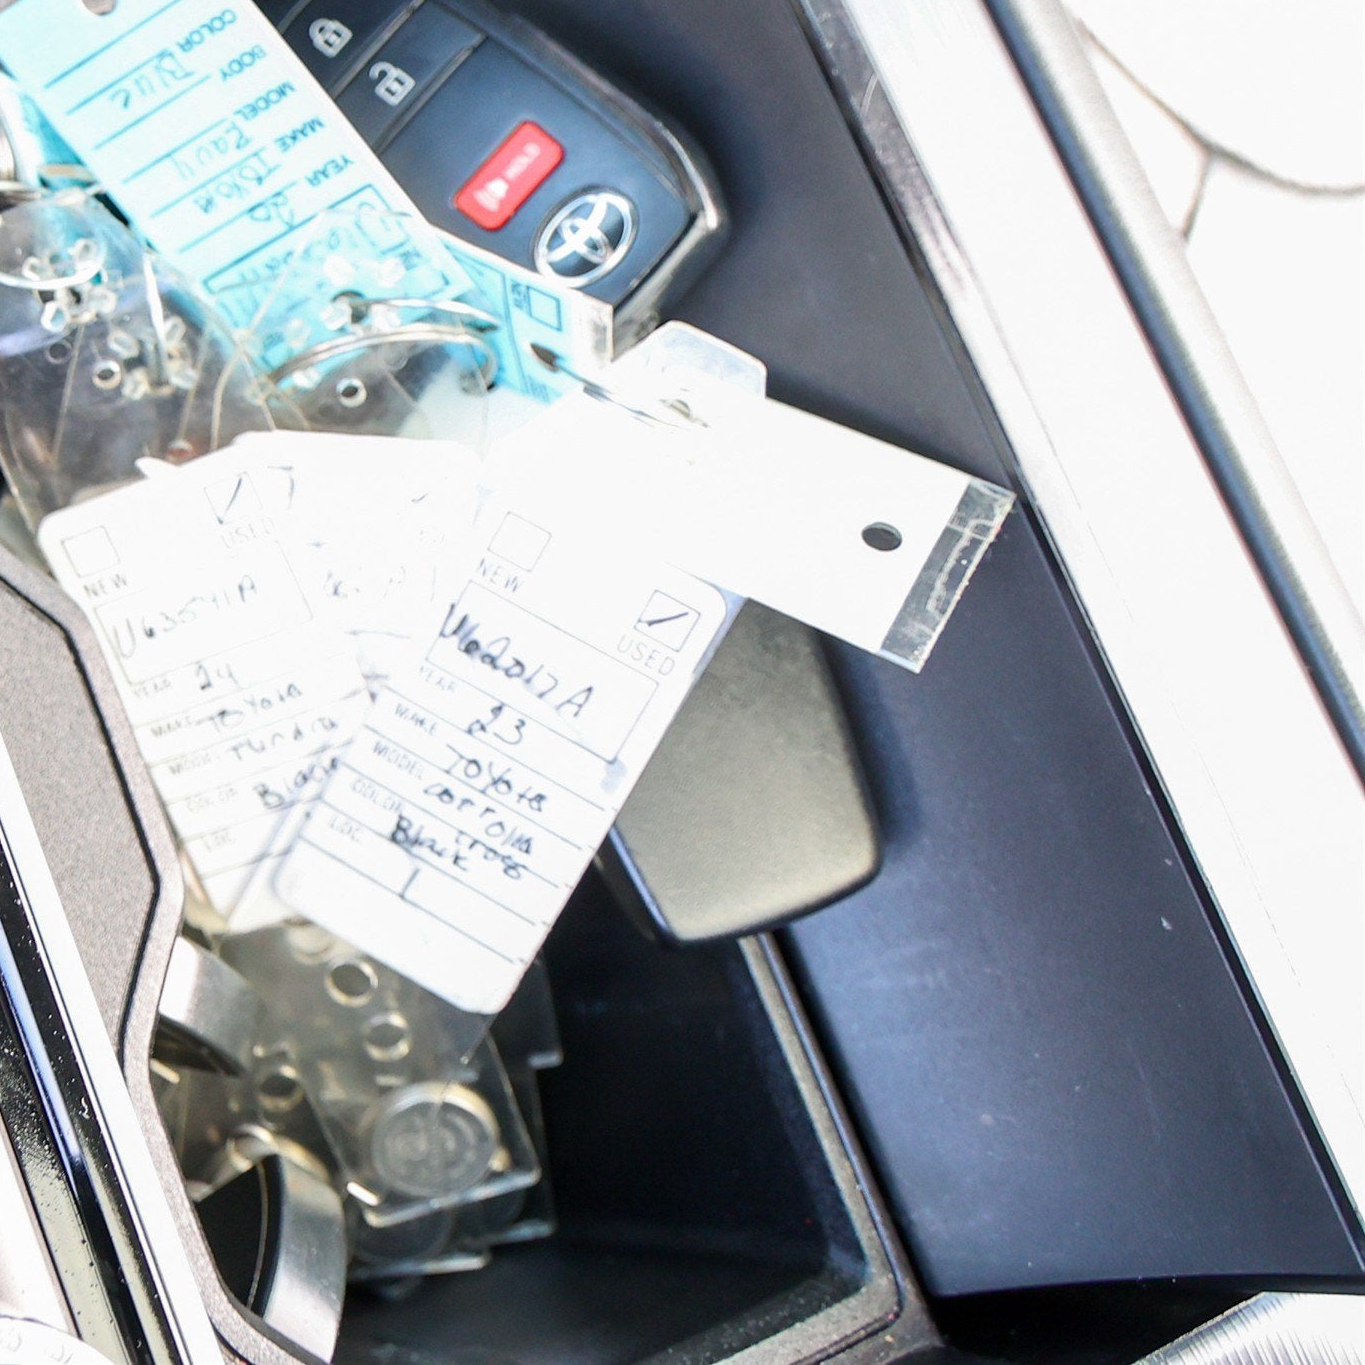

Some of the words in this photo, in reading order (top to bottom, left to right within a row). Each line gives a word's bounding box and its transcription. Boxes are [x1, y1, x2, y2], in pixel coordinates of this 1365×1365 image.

[177, 9, 237, 53] COLOR
[220, 44, 266, 82] BODY
[234, 80, 297, 122] MODEL
[274, 116, 325, 152] MAKE
[304, 154, 354, 187] YEAR
[83, 573, 128, 600] NEW
[475, 557, 526, 595] NEW
[616, 636, 677, 677] USED
